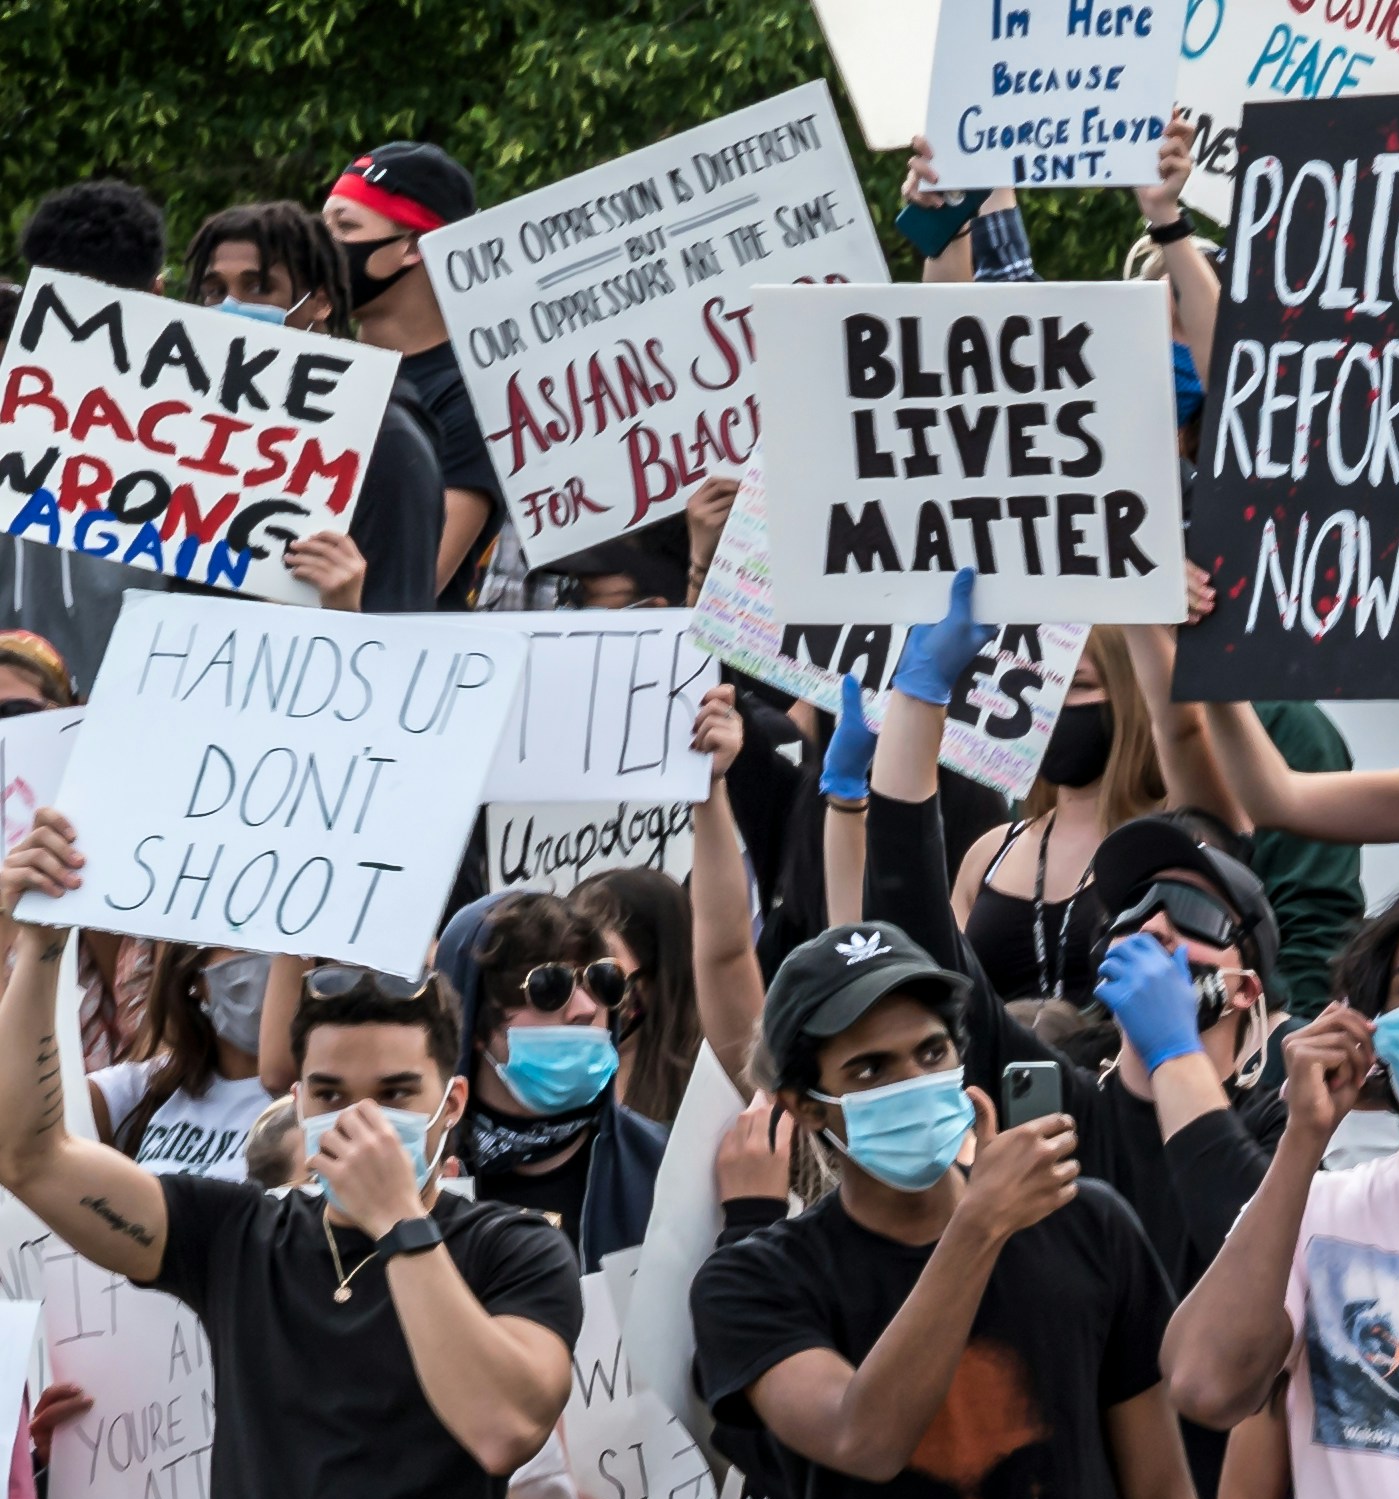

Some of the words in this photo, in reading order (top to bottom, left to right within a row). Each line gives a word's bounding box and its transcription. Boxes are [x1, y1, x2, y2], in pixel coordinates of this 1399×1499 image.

[447, 236, 513, 293] OUR
[520, 177, 664, 264] OPPRESSION
[667, 167, 694, 203] IS
[692, 114, 823, 195] DIFFERENT
[626, 225, 668, 264] BUT
[469, 320, 527, 369] OUR
[531, 256, 676, 344] OPPRESSORS
[681, 236, 724, 288] ARE
[725, 221, 773, 267] THE
[20, 284, 353, 422] MAKE
[842, 312, 1095, 400] BLACK
[0, 365, 361, 514] RACISM
[850, 401, 1105, 480] LIVES
[9, 487, 252, 589] AGAIN
[521, 475, 614, 539] FOR
[822, 490, 1159, 578] MATTER
[136, 622, 385, 722] HANDS
[399, 651, 496, 736] UP
[519, 629, 712, 776] TTER
[104, 834, 406, 945] SHOOT
